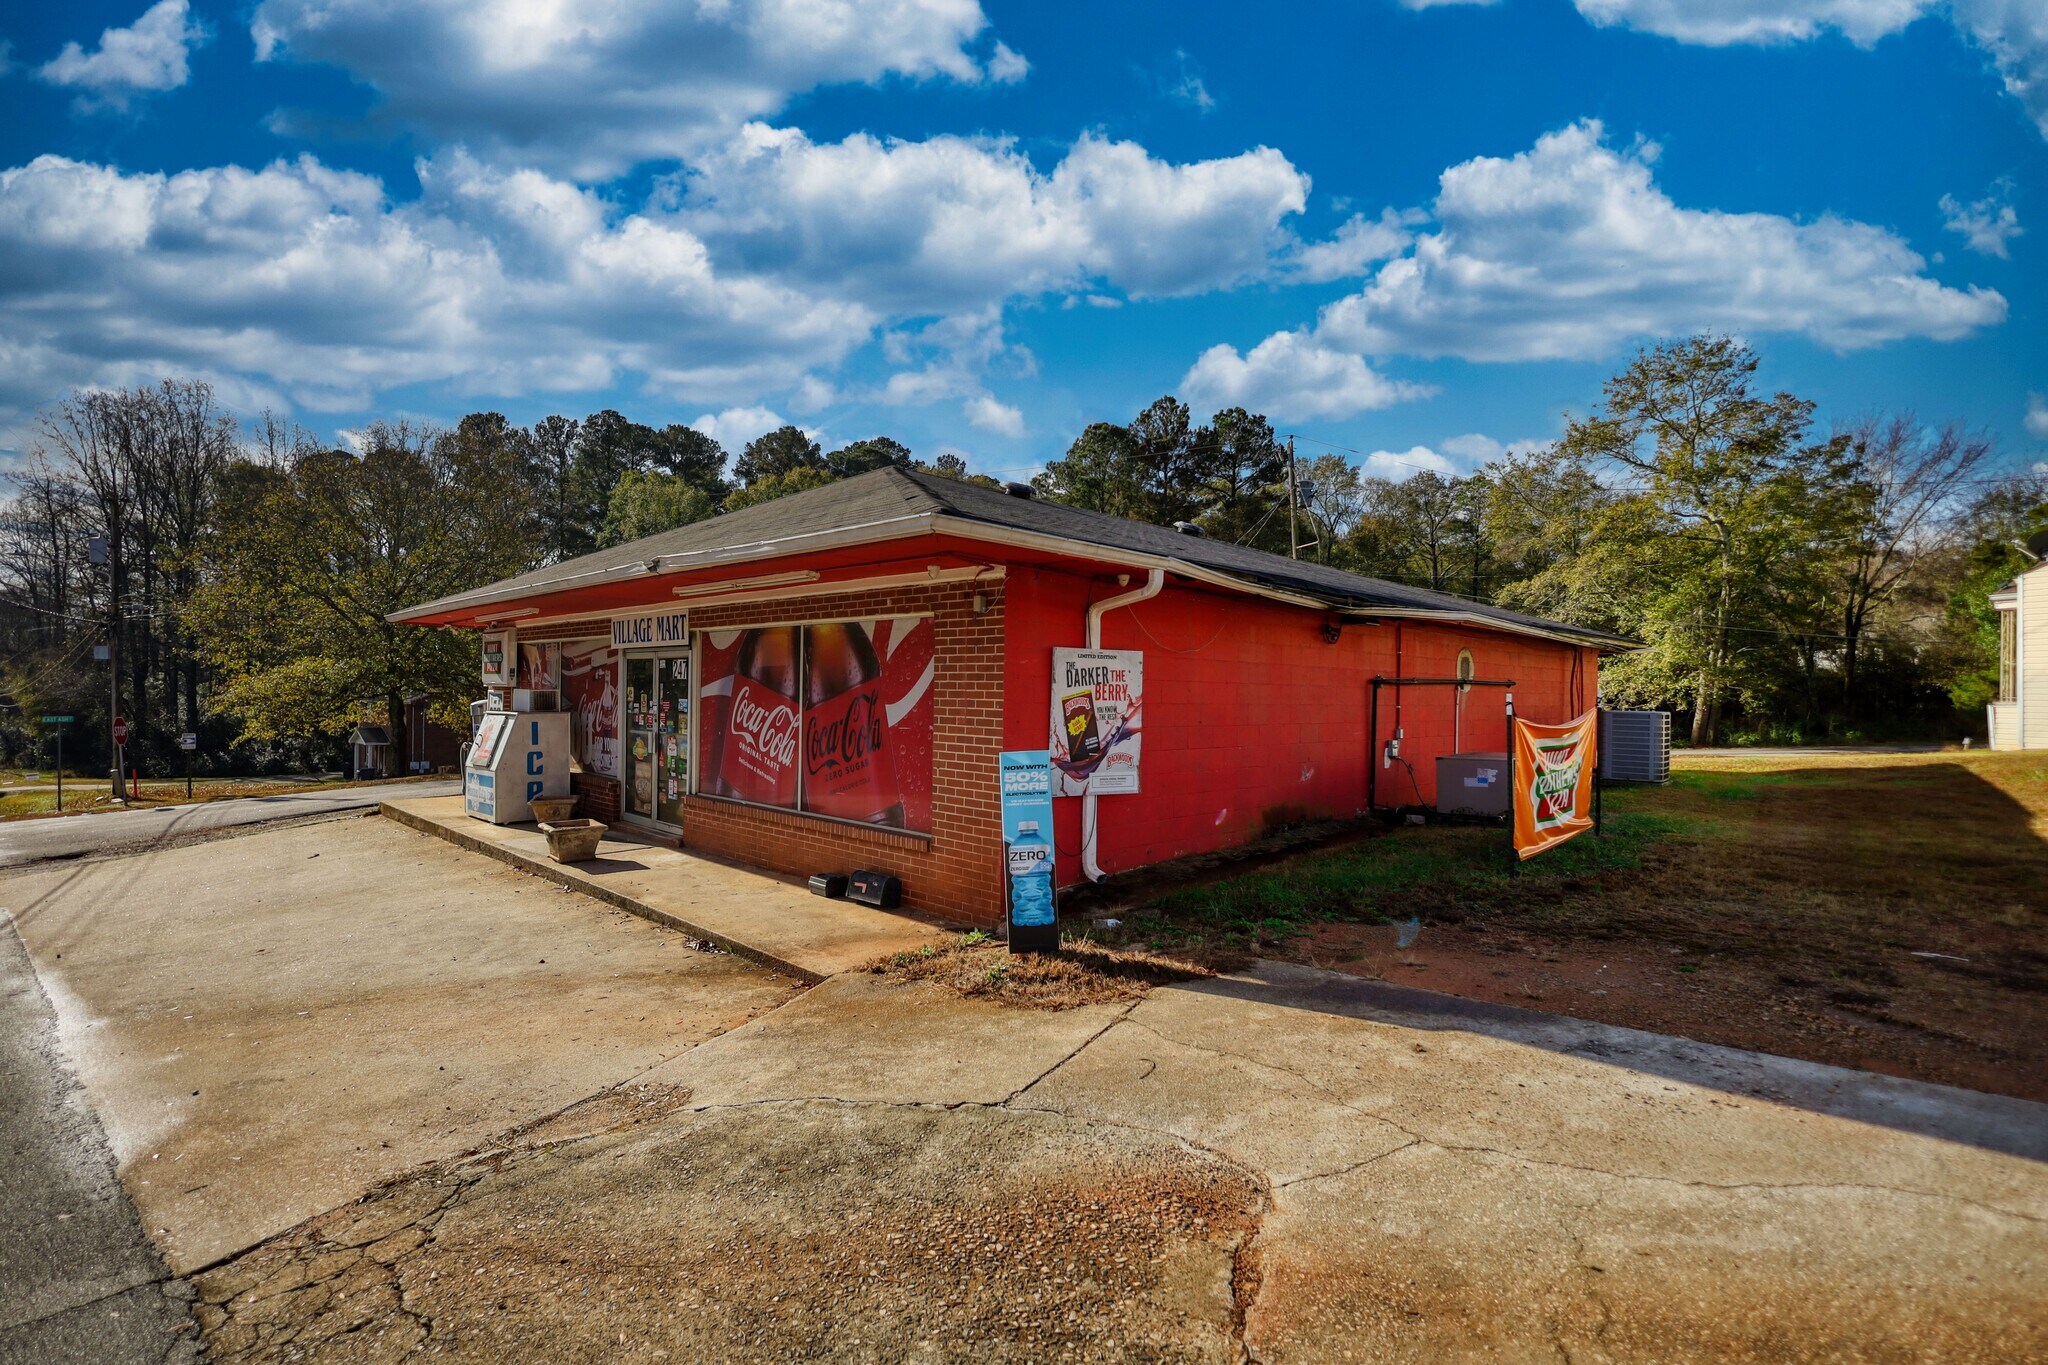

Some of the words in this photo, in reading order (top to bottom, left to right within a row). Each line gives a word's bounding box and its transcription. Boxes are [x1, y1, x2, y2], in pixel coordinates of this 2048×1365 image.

[613, 617, 652, 644] VILLAGE
[657, 614, 686, 641] MART
[673, 659, 687, 679] 247
[1066, 661, 1076, 670] THE
[1066, 666, 1109, 689] DARKER
[1110, 670, 1126, 682] THE
[1094, 684, 1128, 702] BERRY
[1064, 697, 1091, 716] BACKWOODS
[1104, 705, 1117, 714] KNOW
[114, 726, 127, 736] STOP
[731, 686, 800, 768] Coca-Cola
[806, 689, 882, 775] Coca-Cola
[739, 742, 762, 761] ORIGINAL
[764, 757, 779, 772] TASTE
[1107, 753, 1134, 770] BACKWOODS
[825, 769, 843, 782] ZERO
[1004, 771, 1048, 783] 50%
[1005, 781, 1049, 792] MORE
[1010, 850, 1046, 861] ZERO
